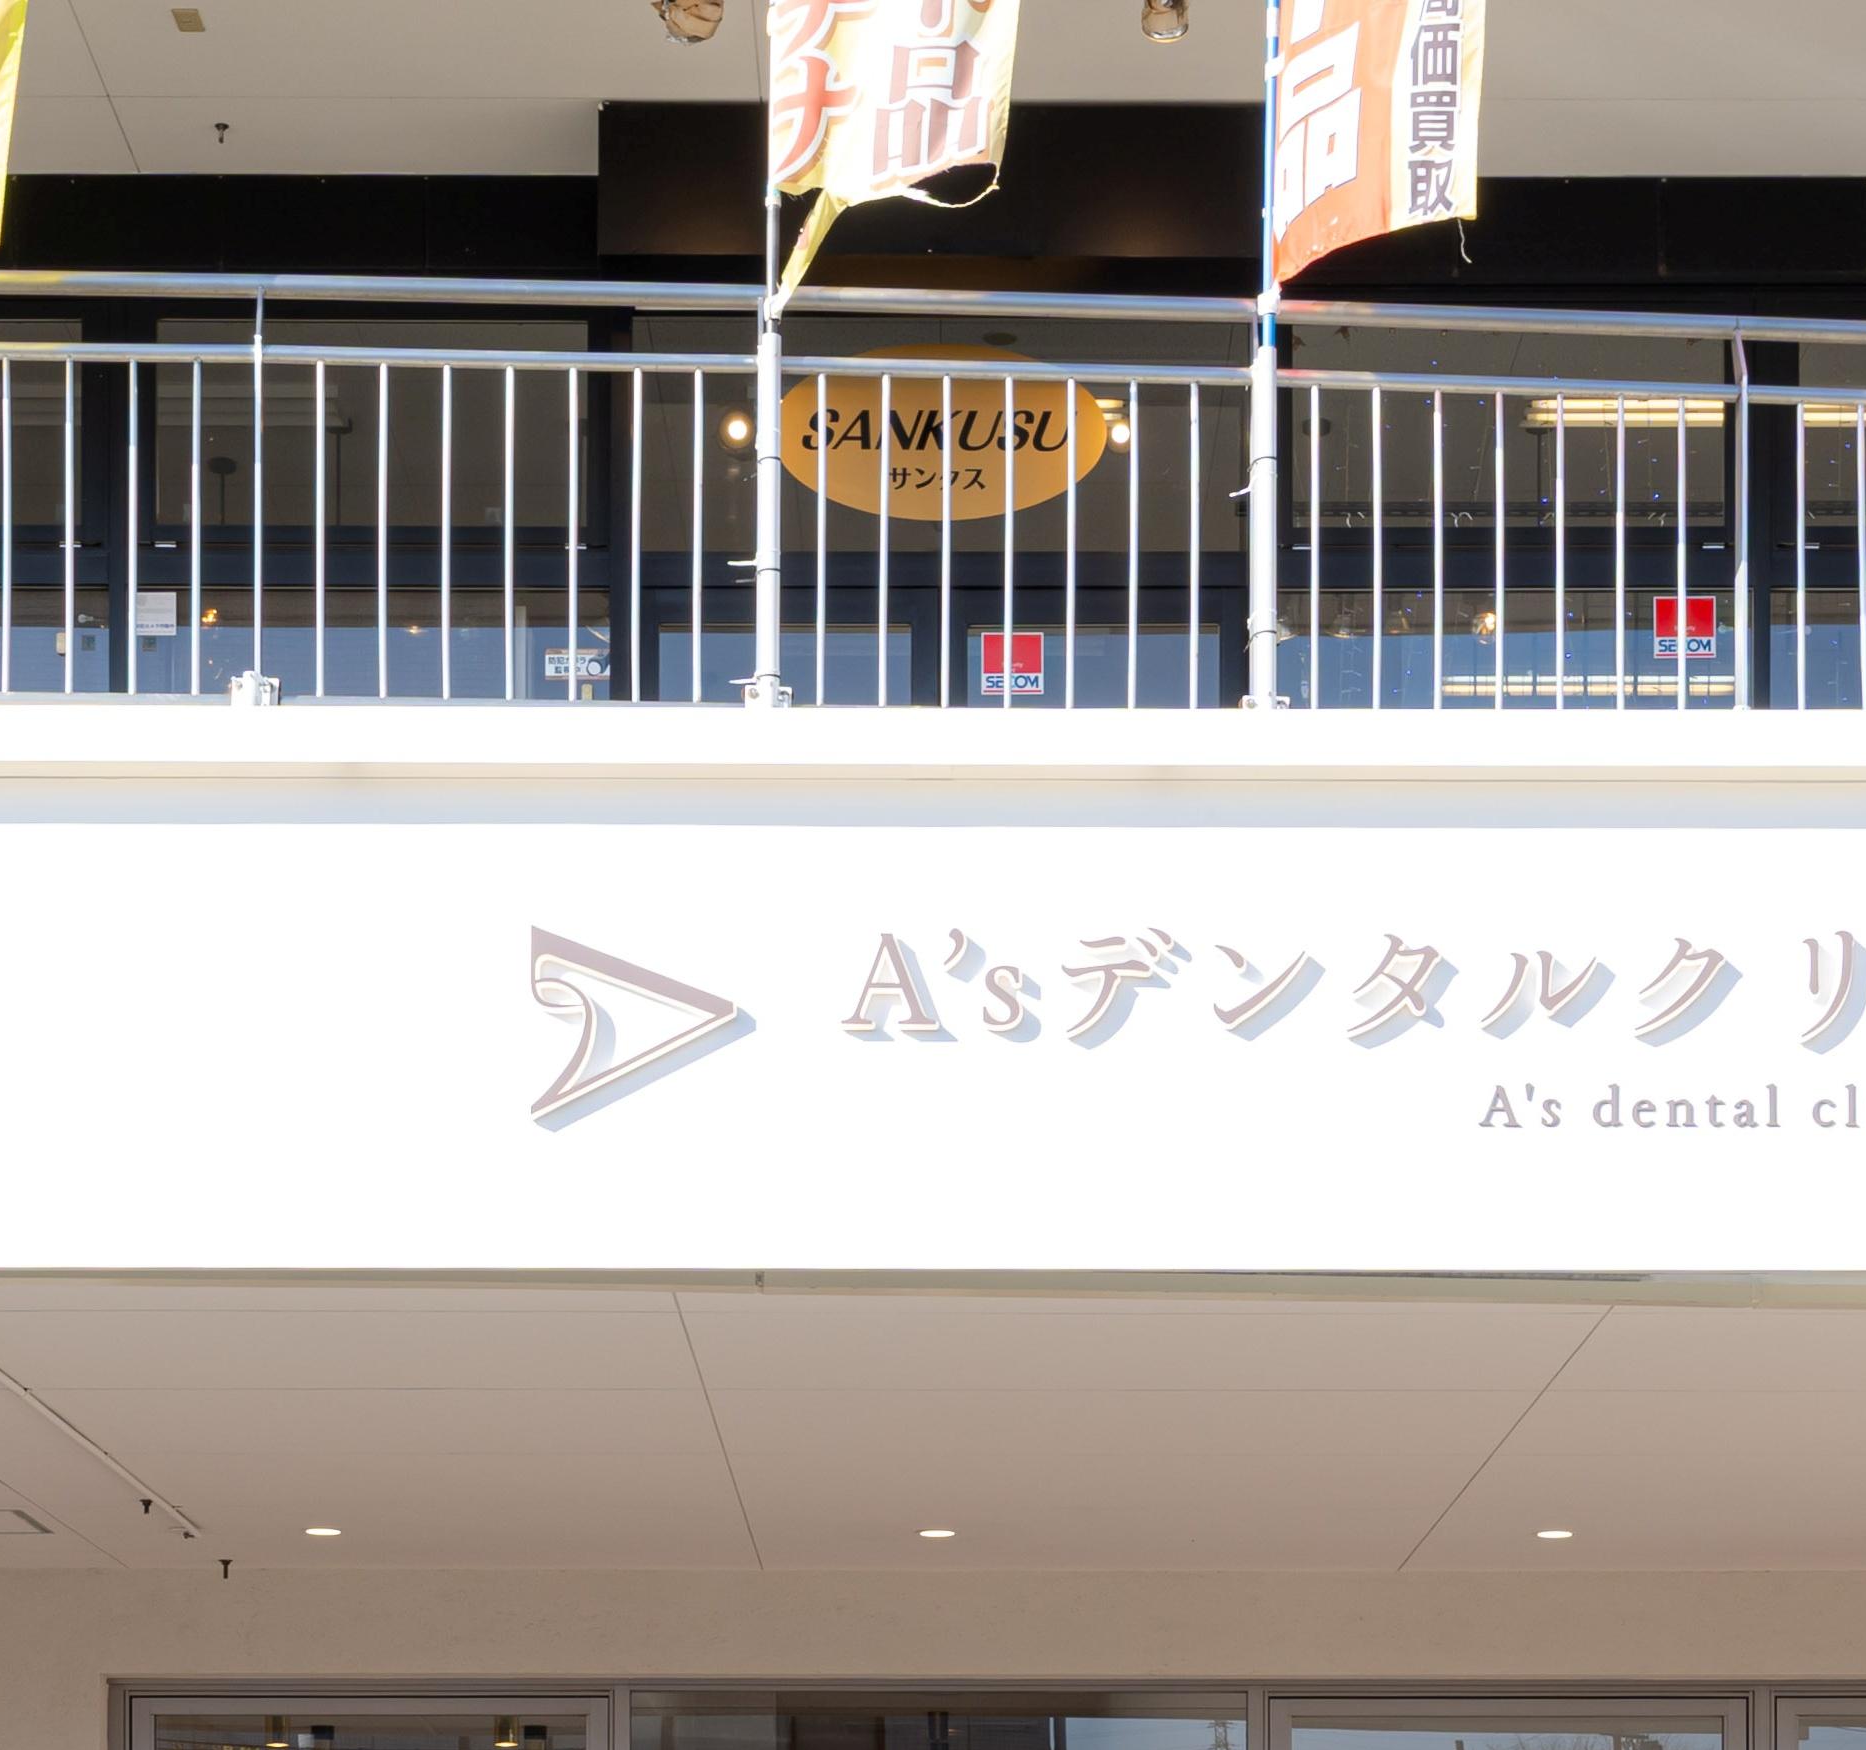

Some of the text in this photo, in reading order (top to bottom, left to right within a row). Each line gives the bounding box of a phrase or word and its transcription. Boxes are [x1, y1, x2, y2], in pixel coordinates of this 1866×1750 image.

[801, 409, 1078, 452] SANKUSU
[1658, 638, 1712, 653] SEOM
[985, 675, 1039, 689] SEOM
[1479, 1084, 1563, 1131] A's
[1591, 1084, 1783, 1131] dental
